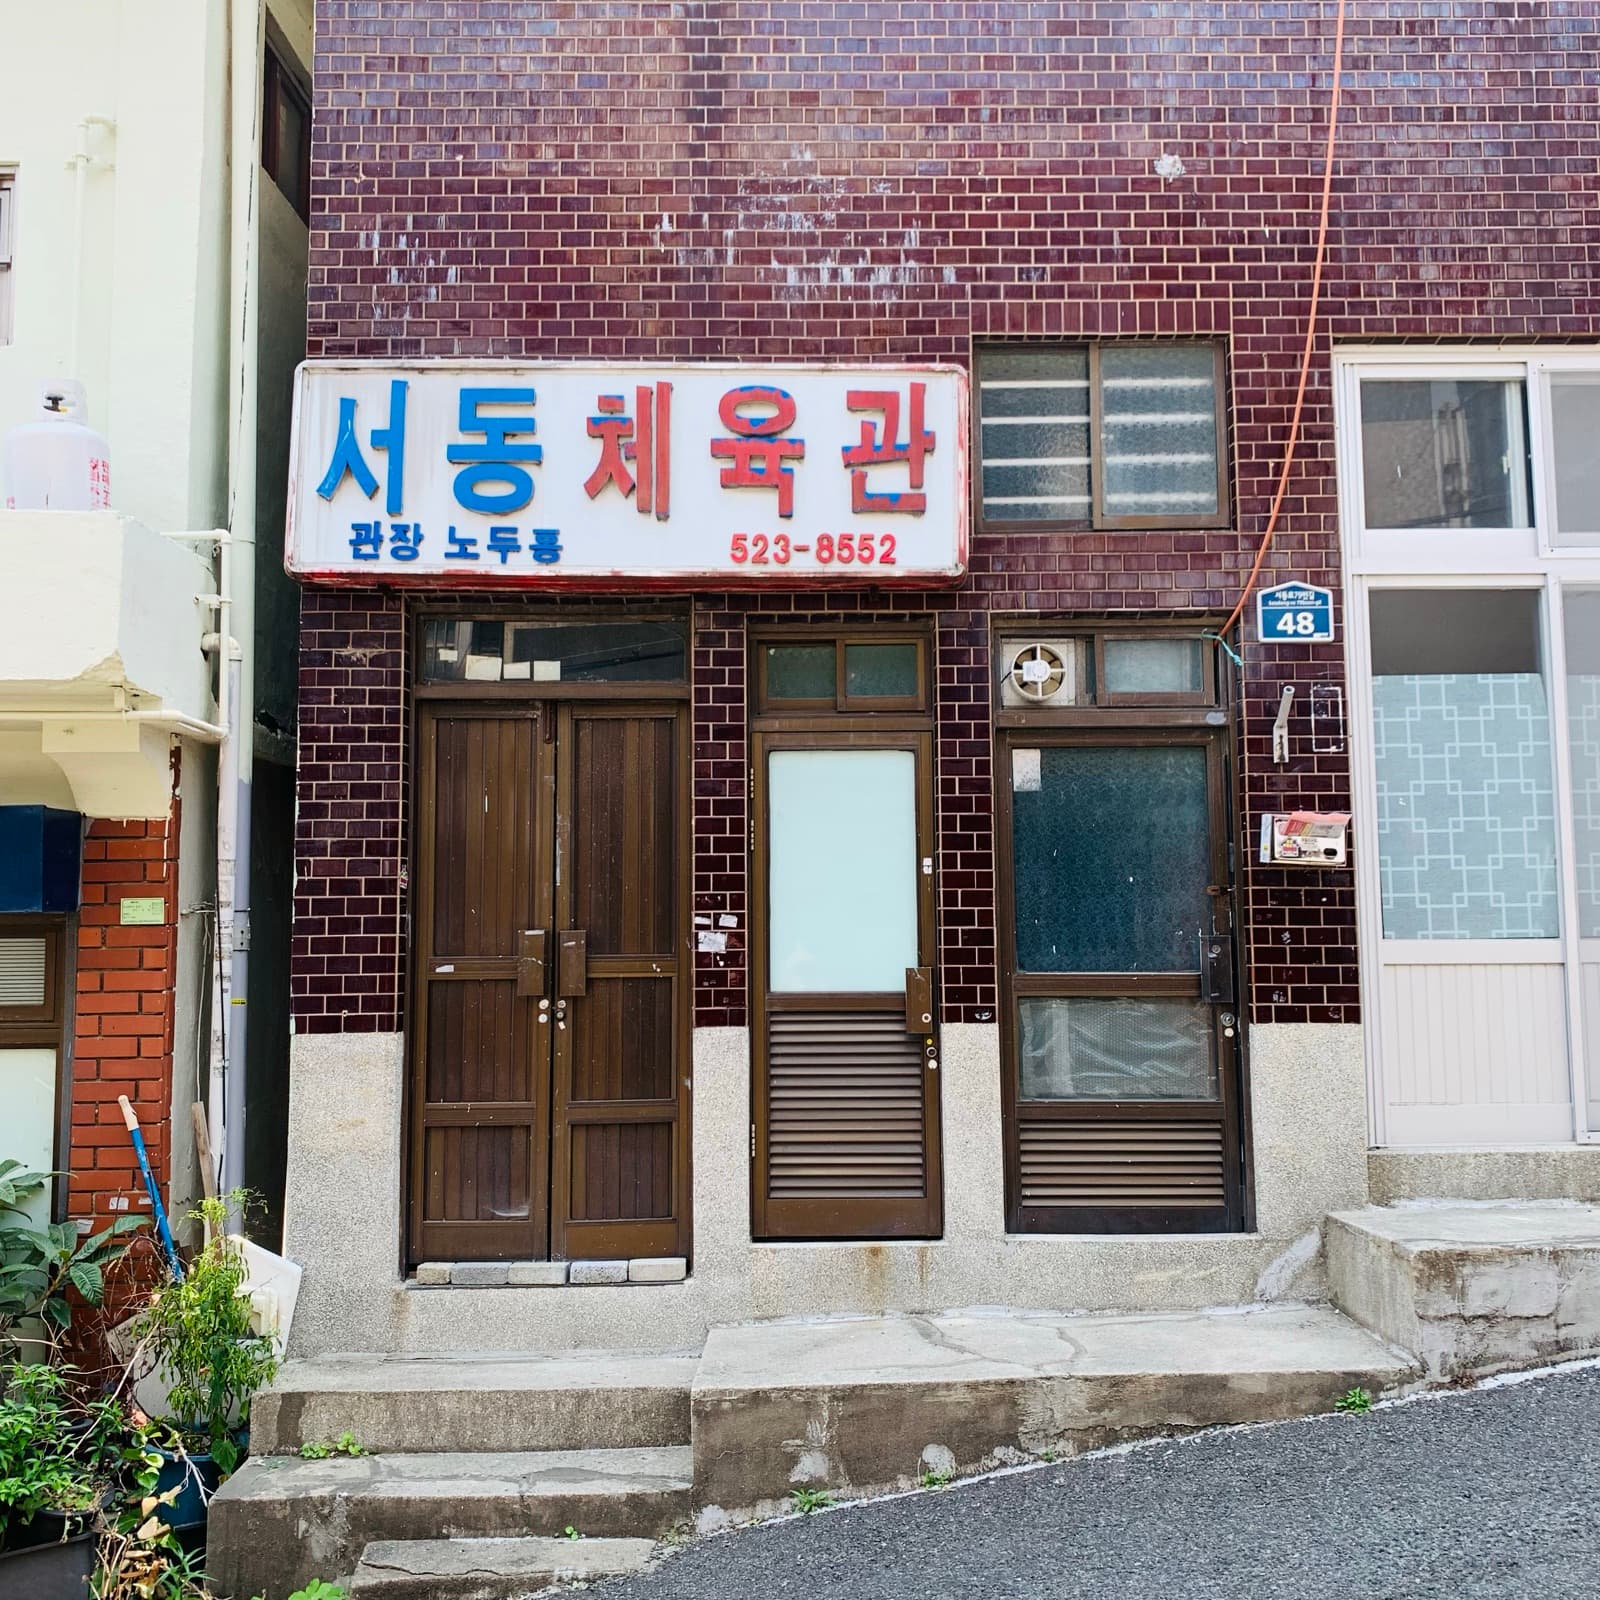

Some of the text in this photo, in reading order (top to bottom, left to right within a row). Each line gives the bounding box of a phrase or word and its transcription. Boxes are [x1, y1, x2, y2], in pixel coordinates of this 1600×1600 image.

[349, 521, 424, 561] 관장
[730, 533, 897, 564] 523-8552
[1276, 612, 1315, 635] 48
